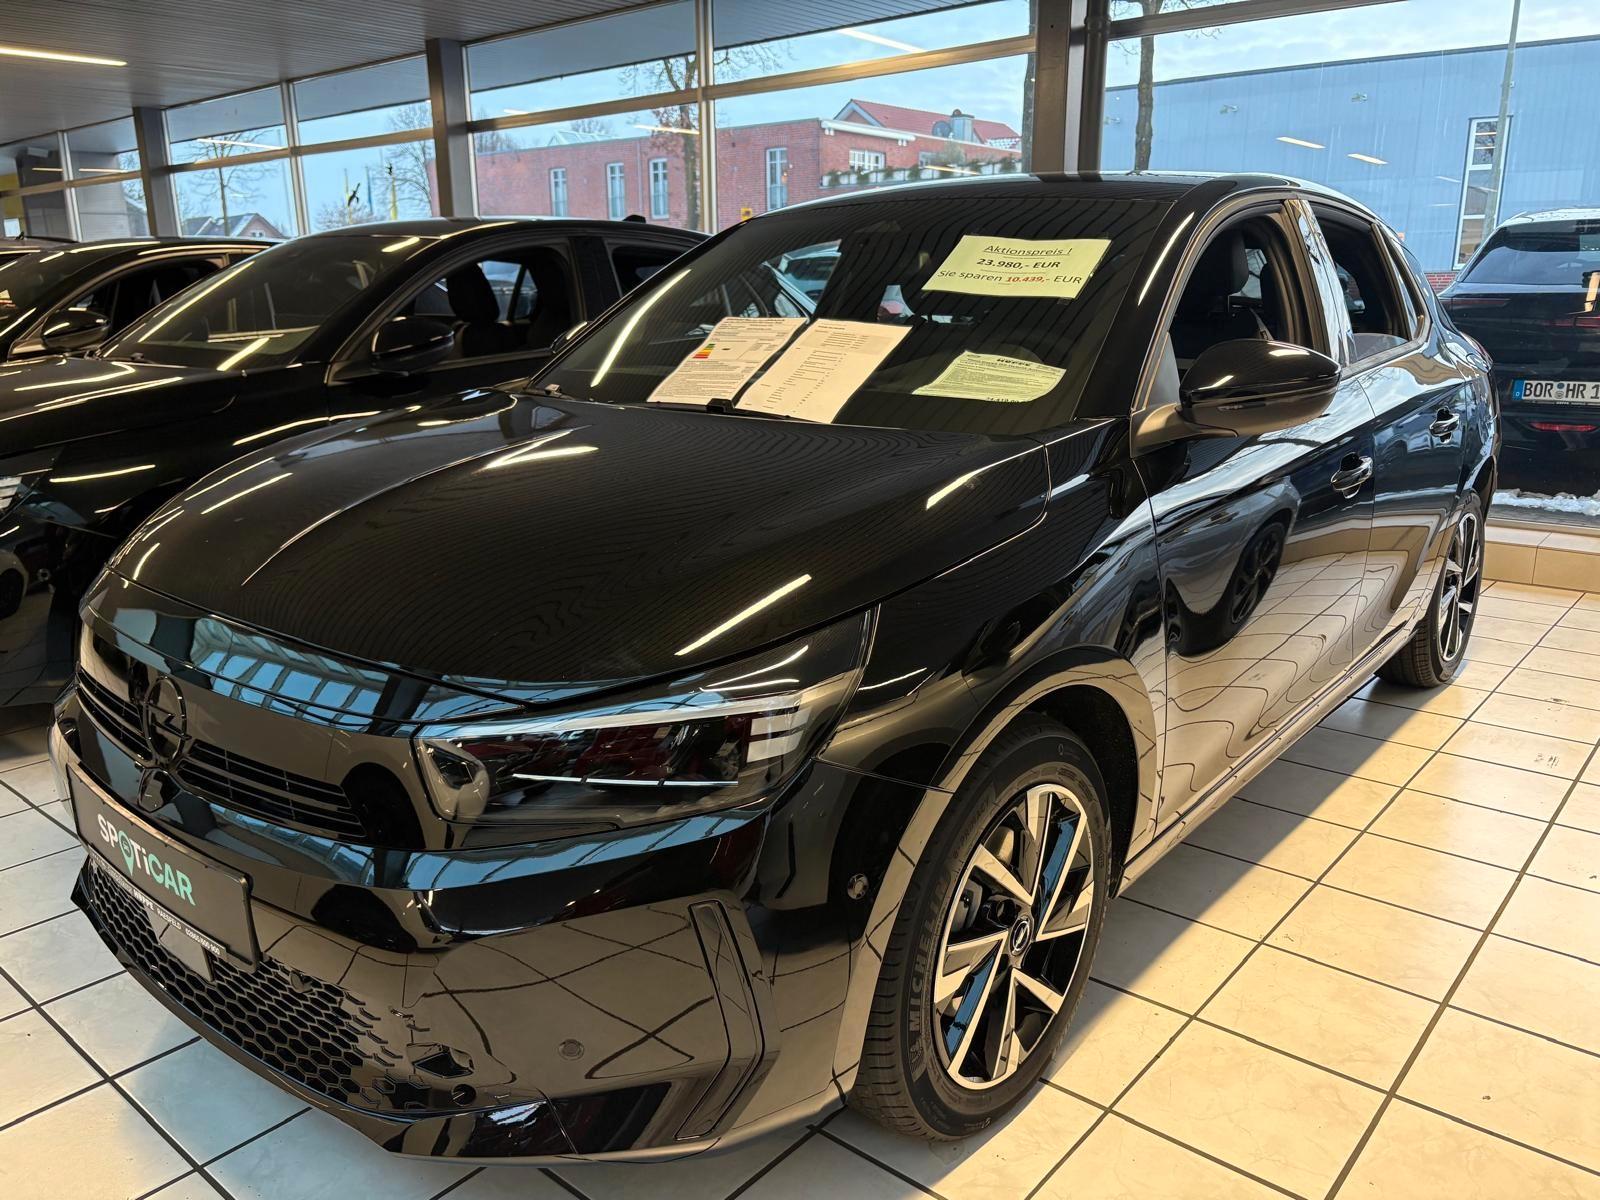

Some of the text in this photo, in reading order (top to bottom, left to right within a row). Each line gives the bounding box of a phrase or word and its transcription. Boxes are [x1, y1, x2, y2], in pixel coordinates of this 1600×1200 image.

[984, 245, 1073, 256] Aktionspreis !
[977, 258, 1061, 269] 23.980,- EUR
[937, 270, 957, 278] Sie
[959, 272, 1002, 282] sparen
[1054, 275, 1083, 284] EUR
[1523, 382, 1554, 398] BOR
[1565, 383, 1587, 399] HR
